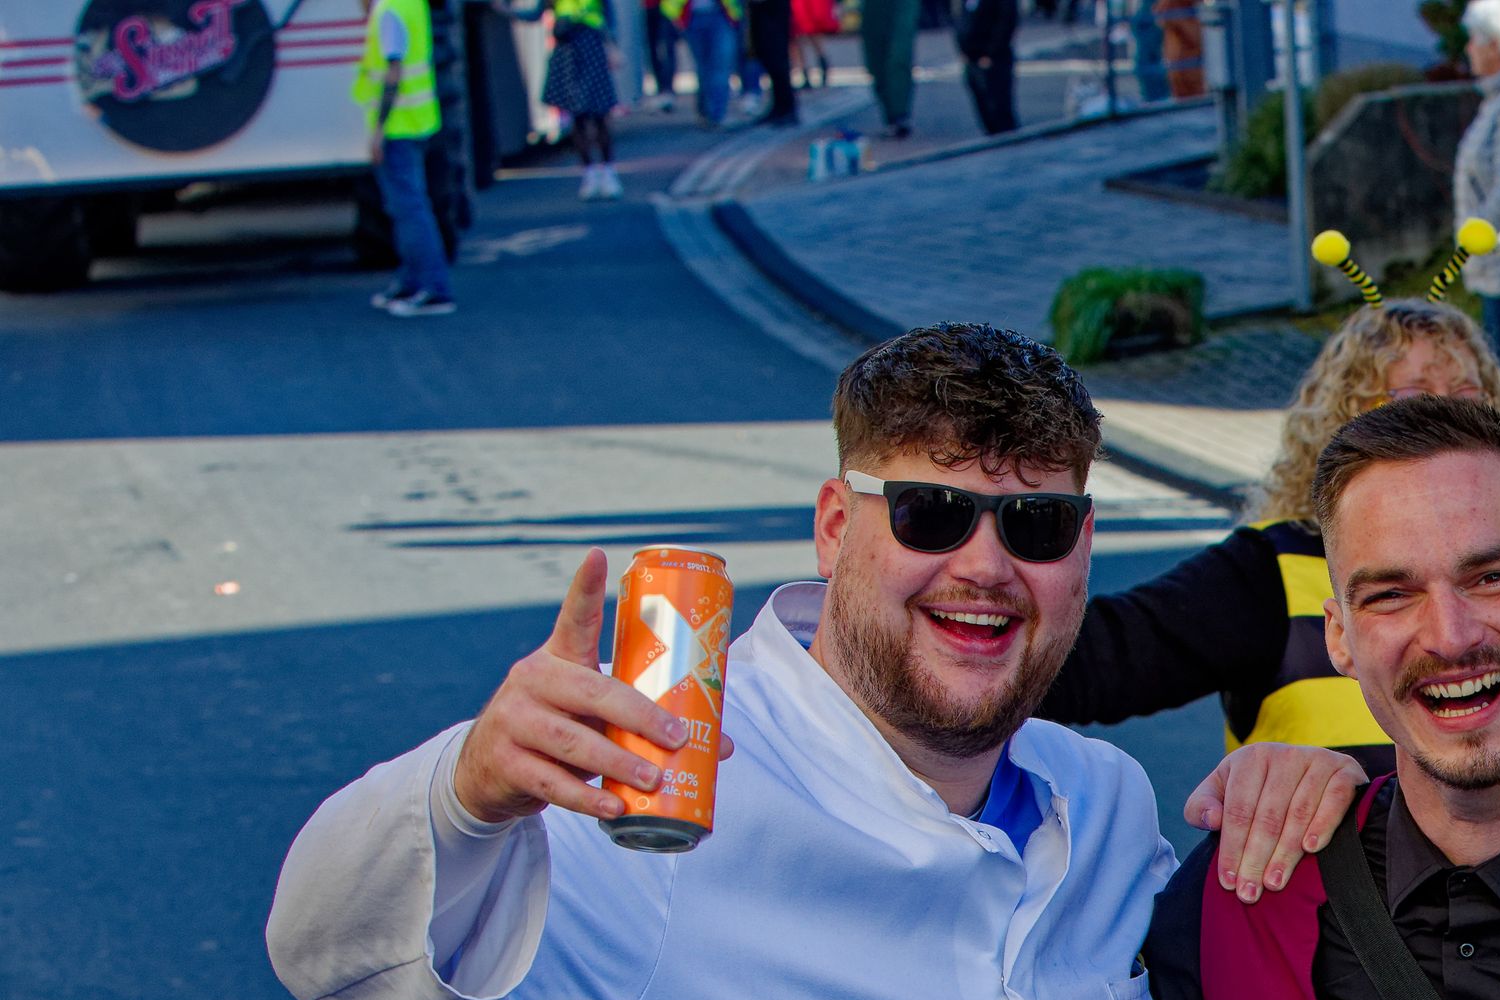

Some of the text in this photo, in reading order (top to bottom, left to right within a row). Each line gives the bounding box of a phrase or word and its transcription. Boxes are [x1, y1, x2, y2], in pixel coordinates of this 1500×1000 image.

[687, 562, 710, 573] SPRITZ
[662, 768, 698, 787] 5,0%
[661, 784, 698, 800] Alc. vol
